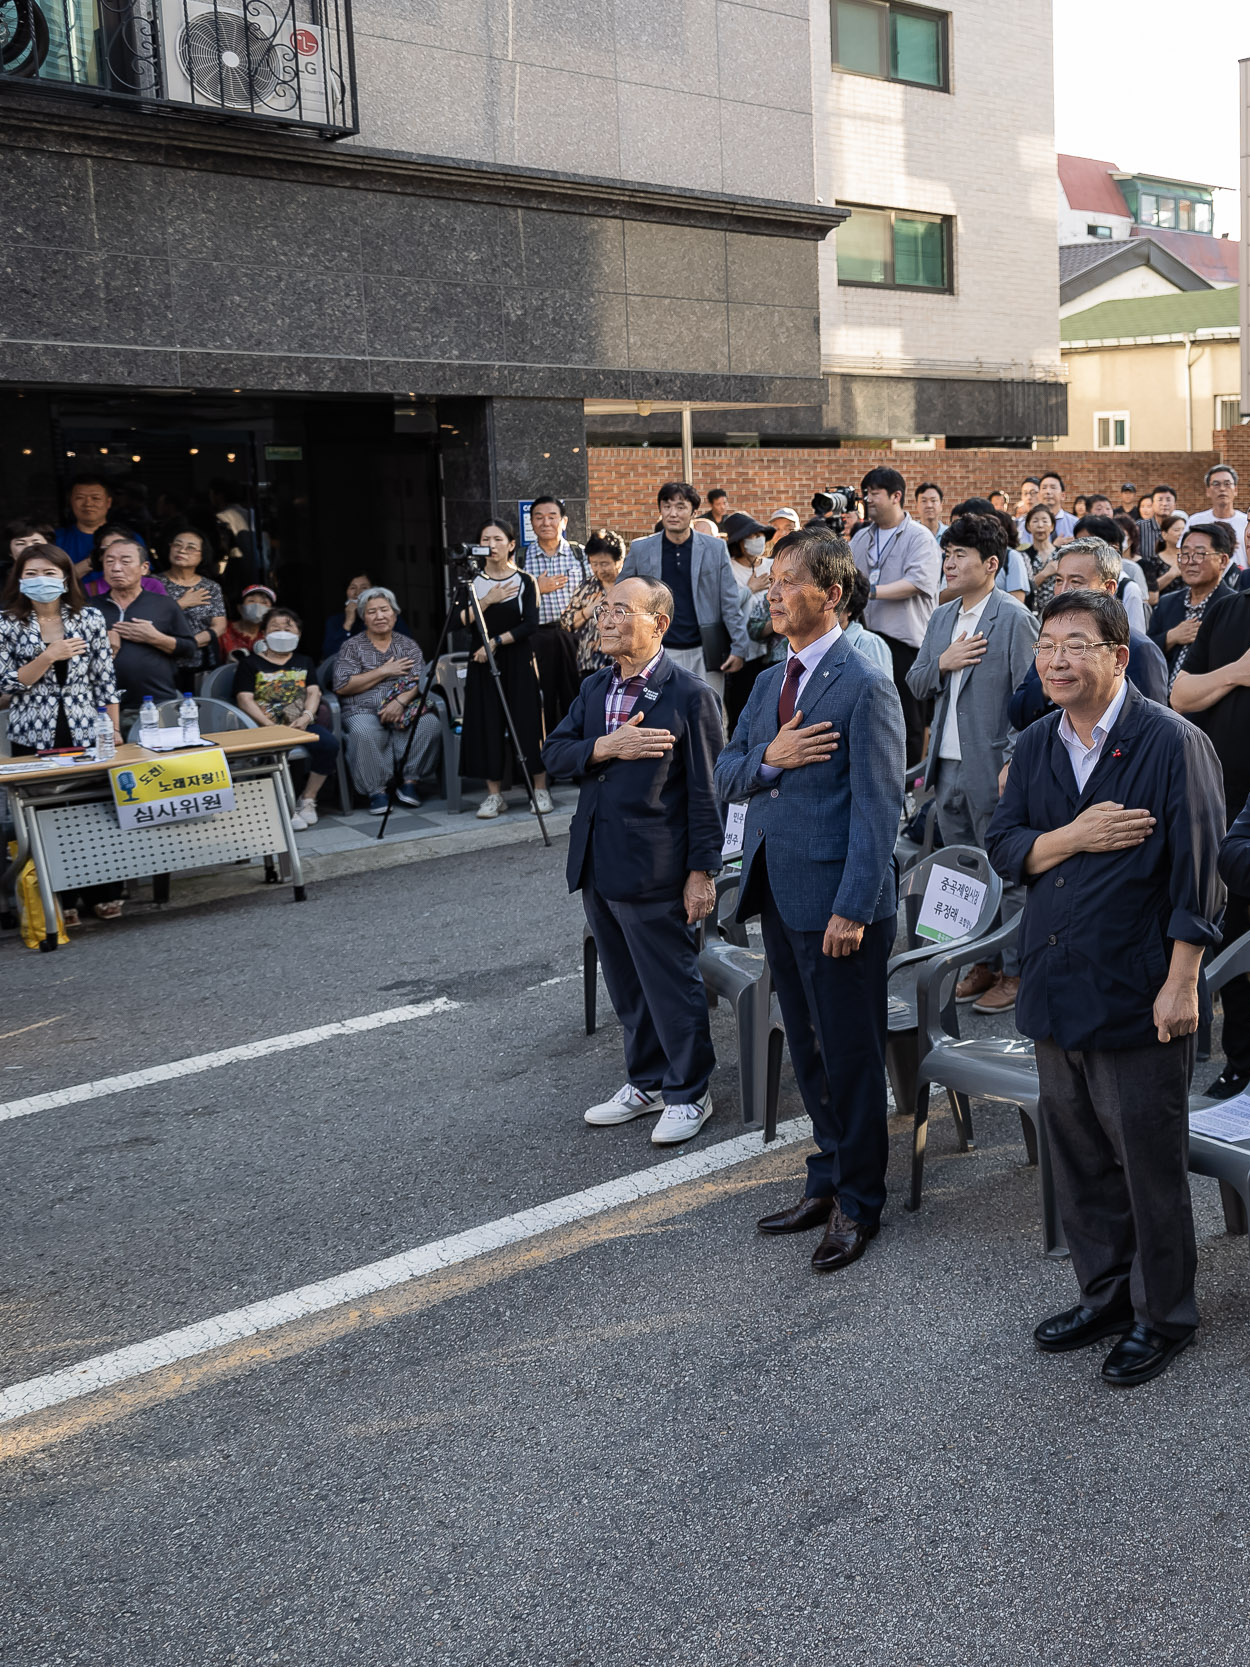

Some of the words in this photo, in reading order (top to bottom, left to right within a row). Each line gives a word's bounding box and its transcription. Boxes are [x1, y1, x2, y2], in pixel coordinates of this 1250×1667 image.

[138, 764, 166, 786] 도전!
[158, 770, 226, 793] 노래자랑!!
[133, 793, 223, 824] 심사위원
[941, 876, 980, 905] 중곡제일시장
[934, 901, 959, 922] 류정래
